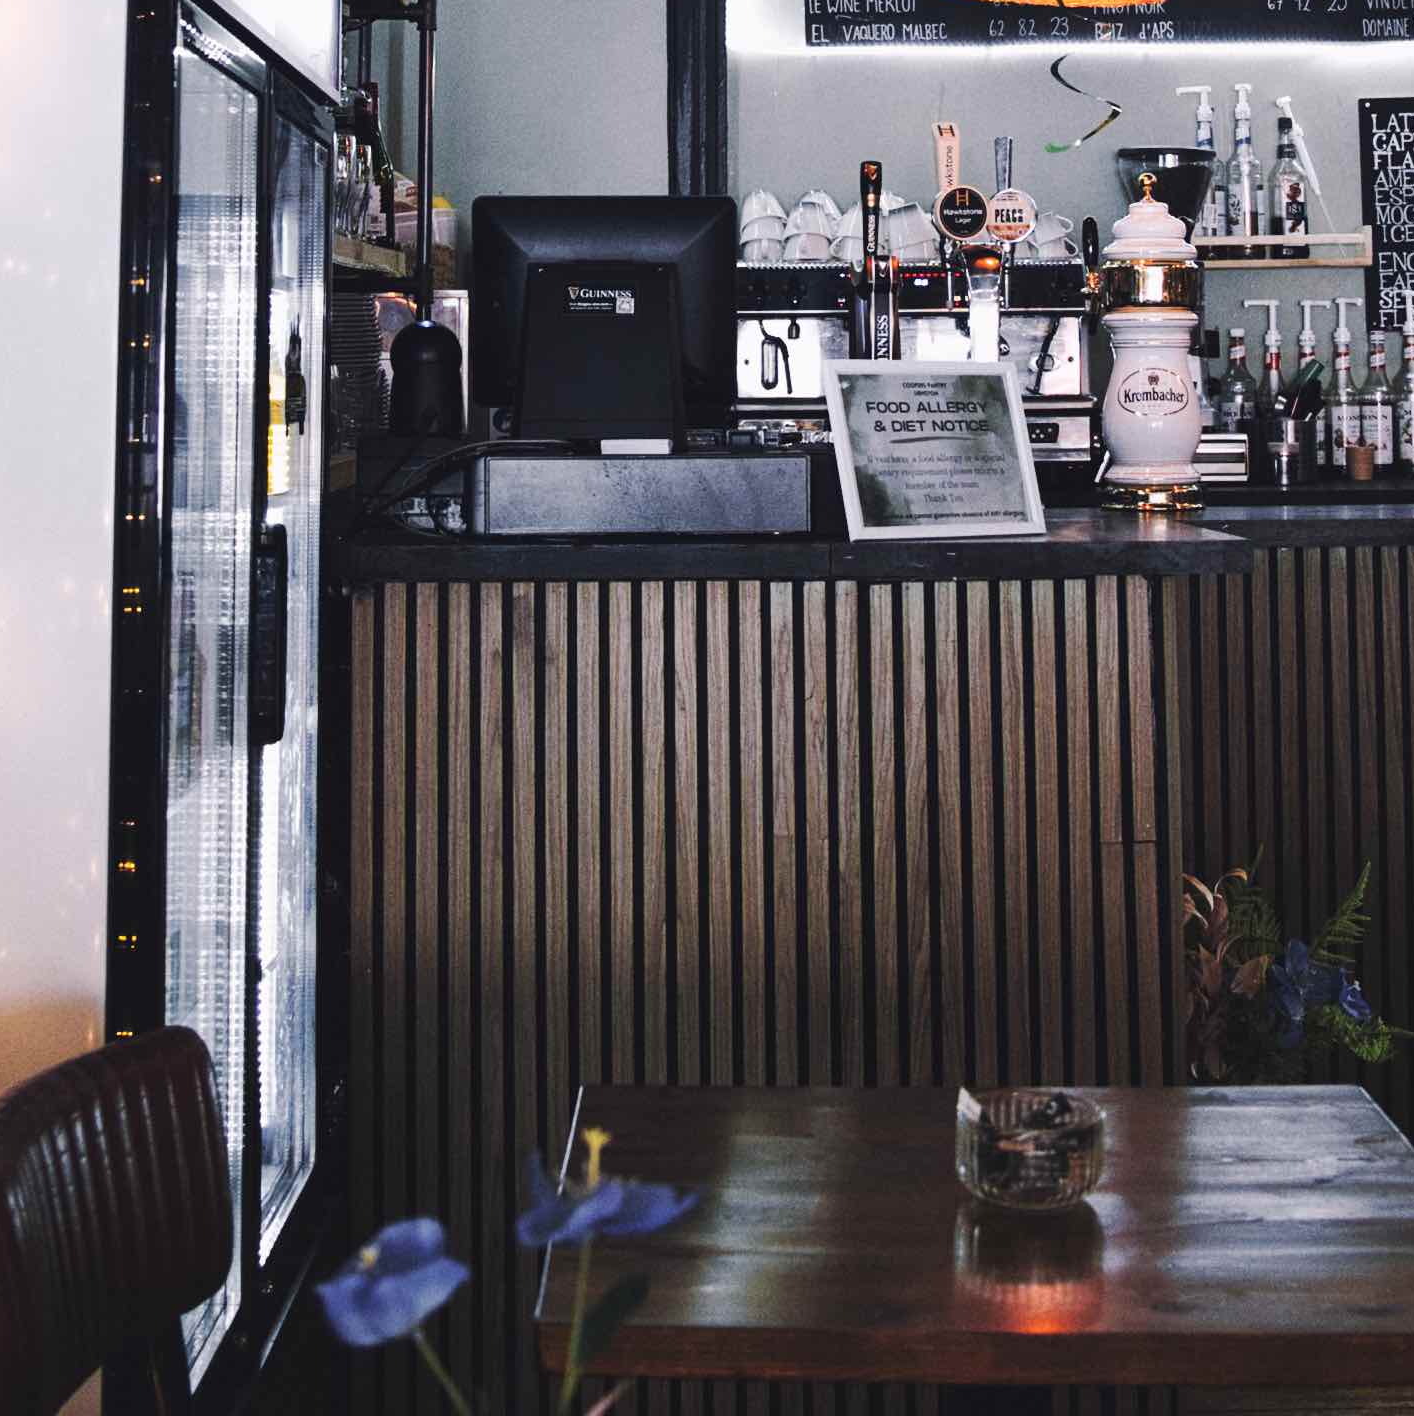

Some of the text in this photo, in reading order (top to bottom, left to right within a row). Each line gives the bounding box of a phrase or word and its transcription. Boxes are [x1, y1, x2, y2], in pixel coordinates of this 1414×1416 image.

[812, 22, 947, 43] EL VAQUERO MALBEC
[1362, 18, 1410, 37] DOMAINE
[580, 289, 632, 298] GUINNESS
[1124, 387, 1184, 404] Krombacher
[866, 402, 987, 414] FOOD ALLERGY
[874, 420, 988, 432] & DIET NOTICE
